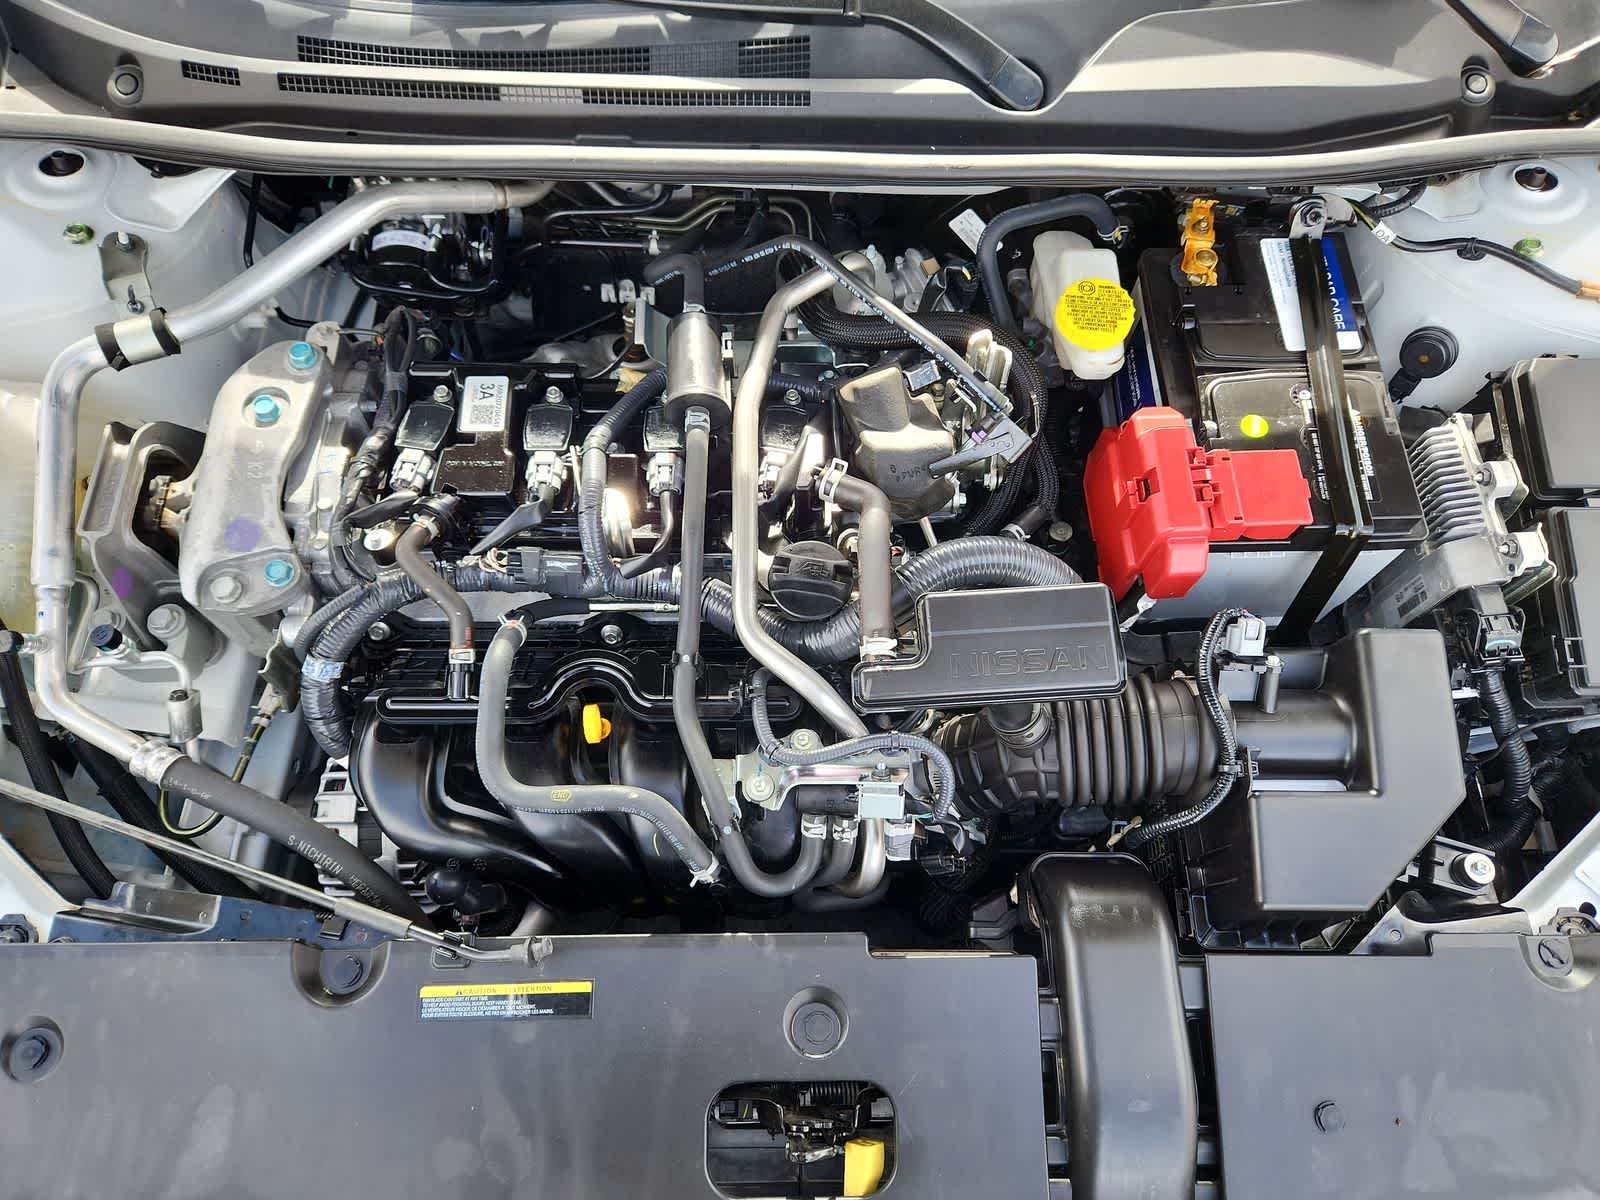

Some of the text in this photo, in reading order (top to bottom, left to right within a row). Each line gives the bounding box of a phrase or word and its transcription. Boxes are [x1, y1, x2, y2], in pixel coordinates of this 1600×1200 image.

[479, 383, 496, 401] 3A
[950, 644, 1109, 680] NISSAN
[463, 987, 497, 995] CAUTION
